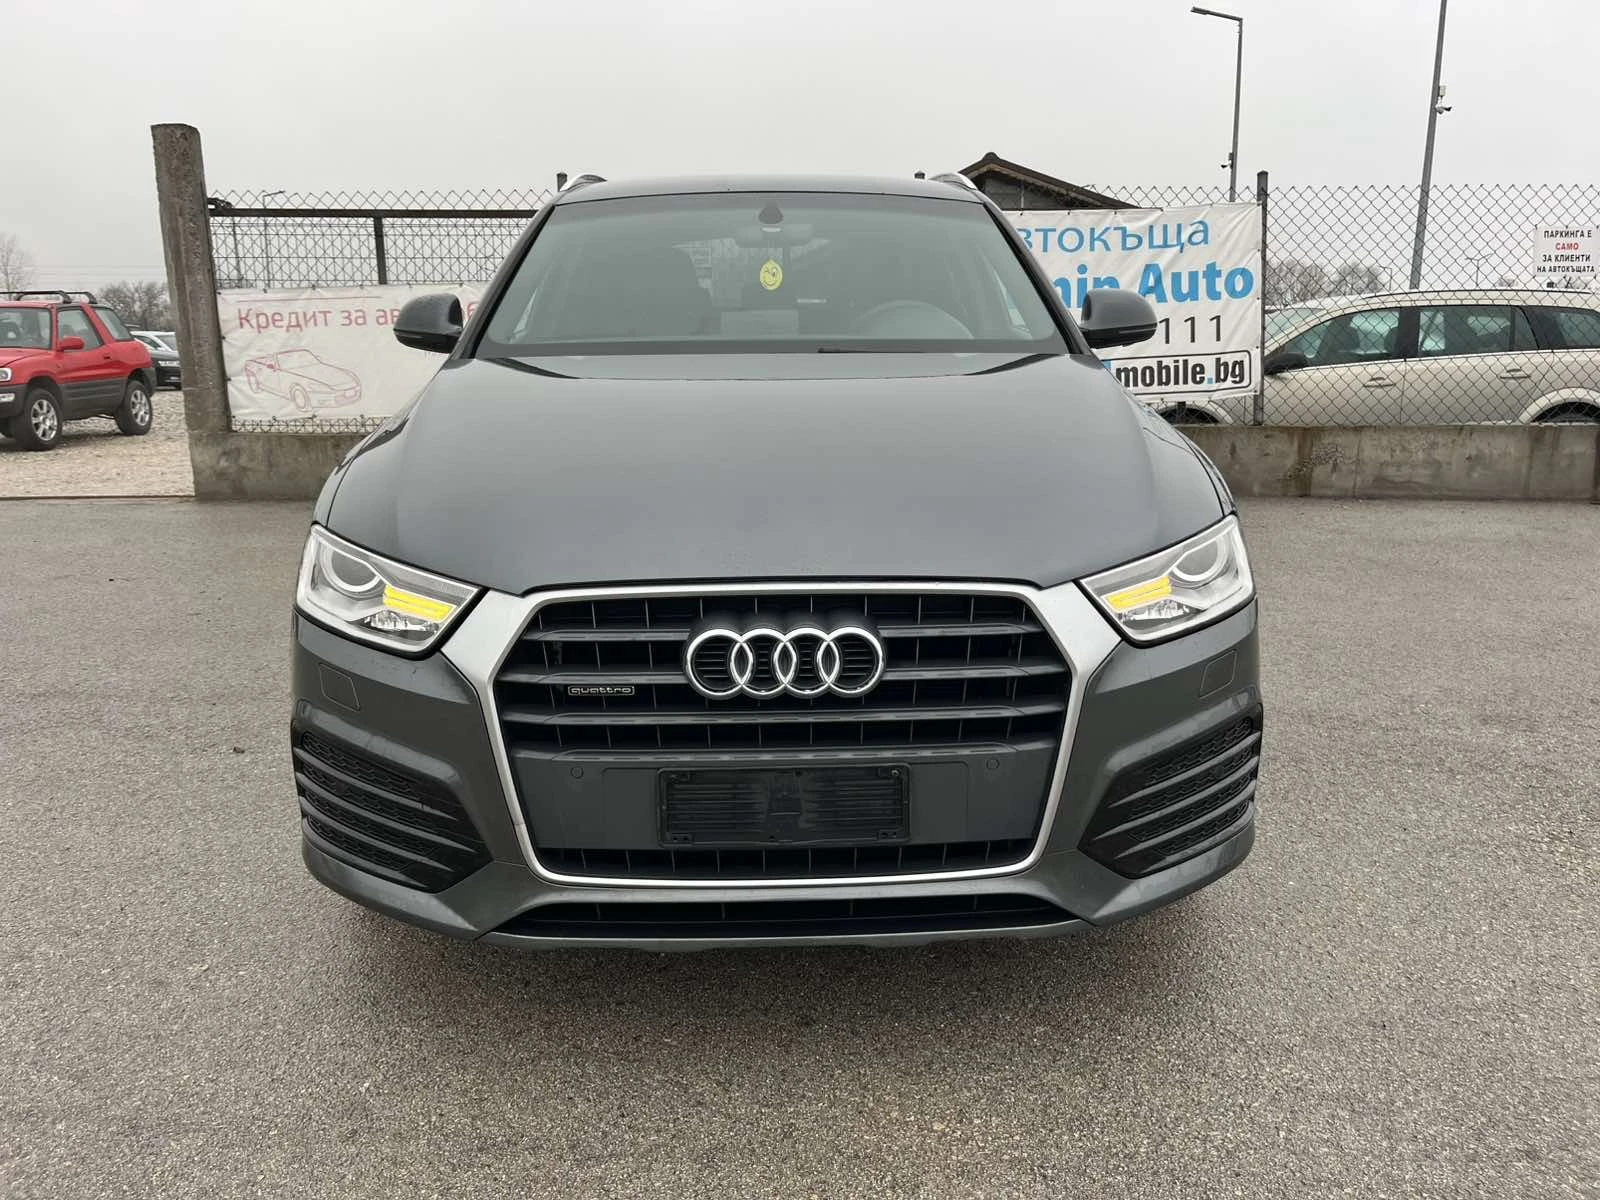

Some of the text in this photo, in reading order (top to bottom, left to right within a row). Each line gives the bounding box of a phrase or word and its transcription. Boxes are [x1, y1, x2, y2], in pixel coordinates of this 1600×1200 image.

[1016, 219, 1210, 254] втокъща
[1543, 229, 1593, 239] ПАРКИНГА Е
[1555, 242, 1579, 250] САМО
[1542, 254, 1591, 262] ЗА КЛИЕНТИ
[1536, 265, 1595, 274] НА АВТОКЪЩАТА
[1137, 261, 1255, 304] Auto
[238, 307, 333, 334] Кредит
[340, 309, 368, 327] за
[1115, 357, 1246, 388] mobile.bg
[570, 686, 632, 696] quattro
